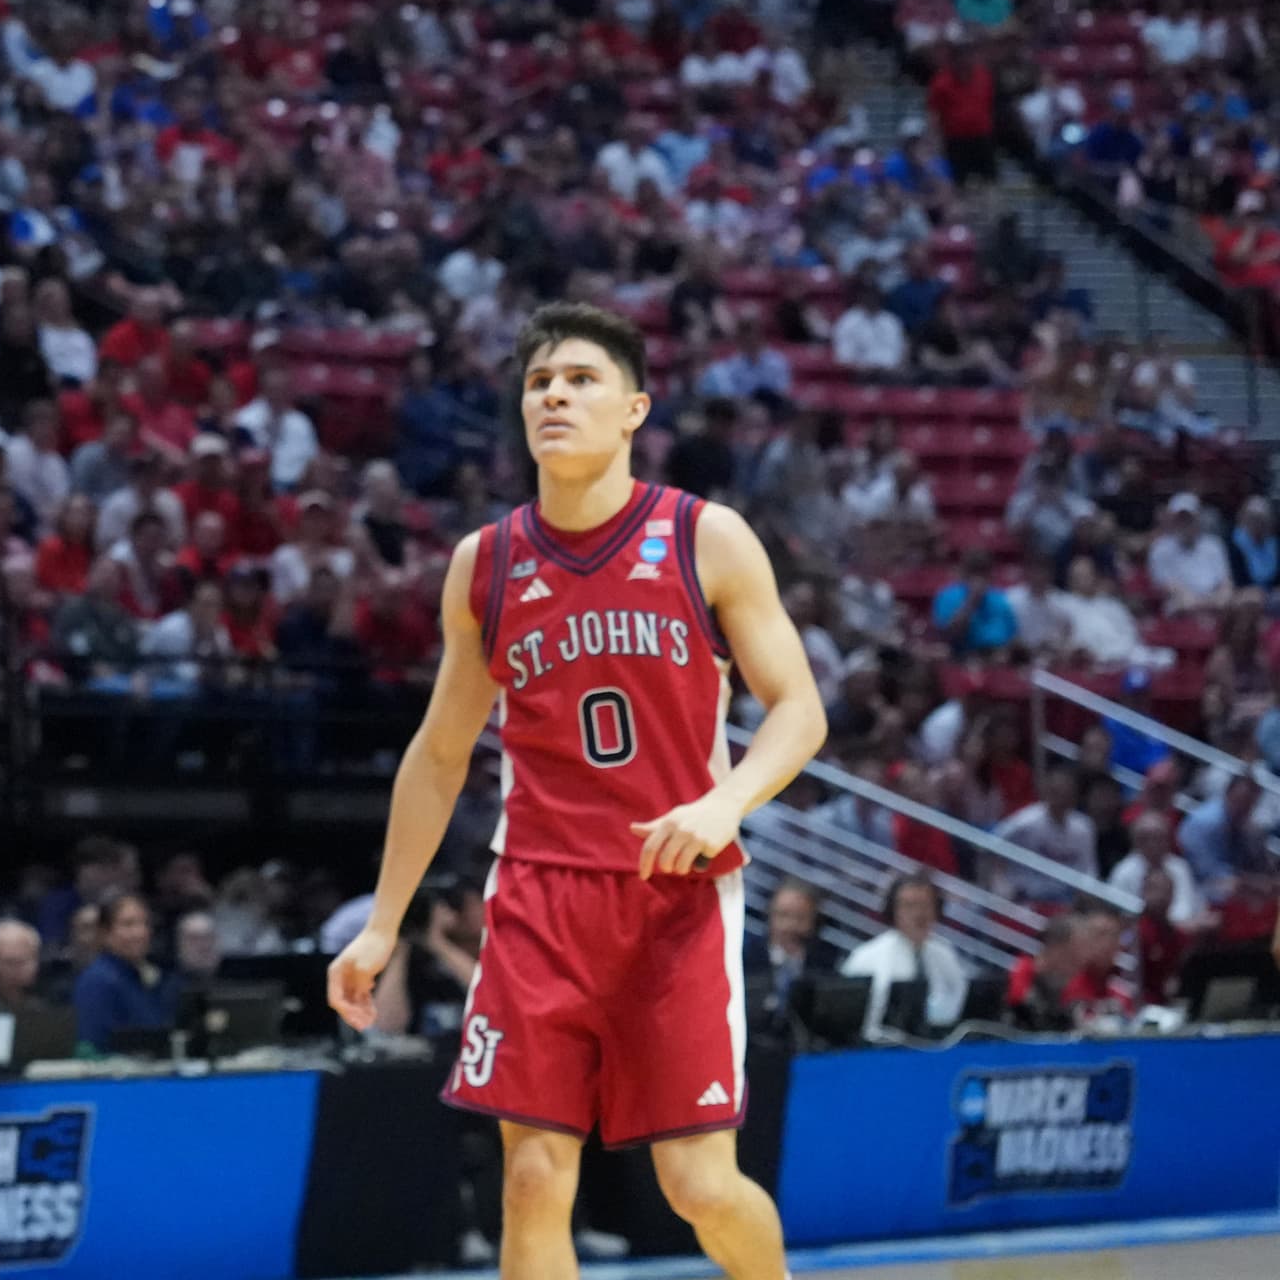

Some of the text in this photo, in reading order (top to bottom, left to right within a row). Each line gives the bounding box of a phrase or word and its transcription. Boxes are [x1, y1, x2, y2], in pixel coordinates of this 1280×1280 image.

[506, 610, 690, 690] ST. JOHN'S
[578, 686, 638, 768] 0
